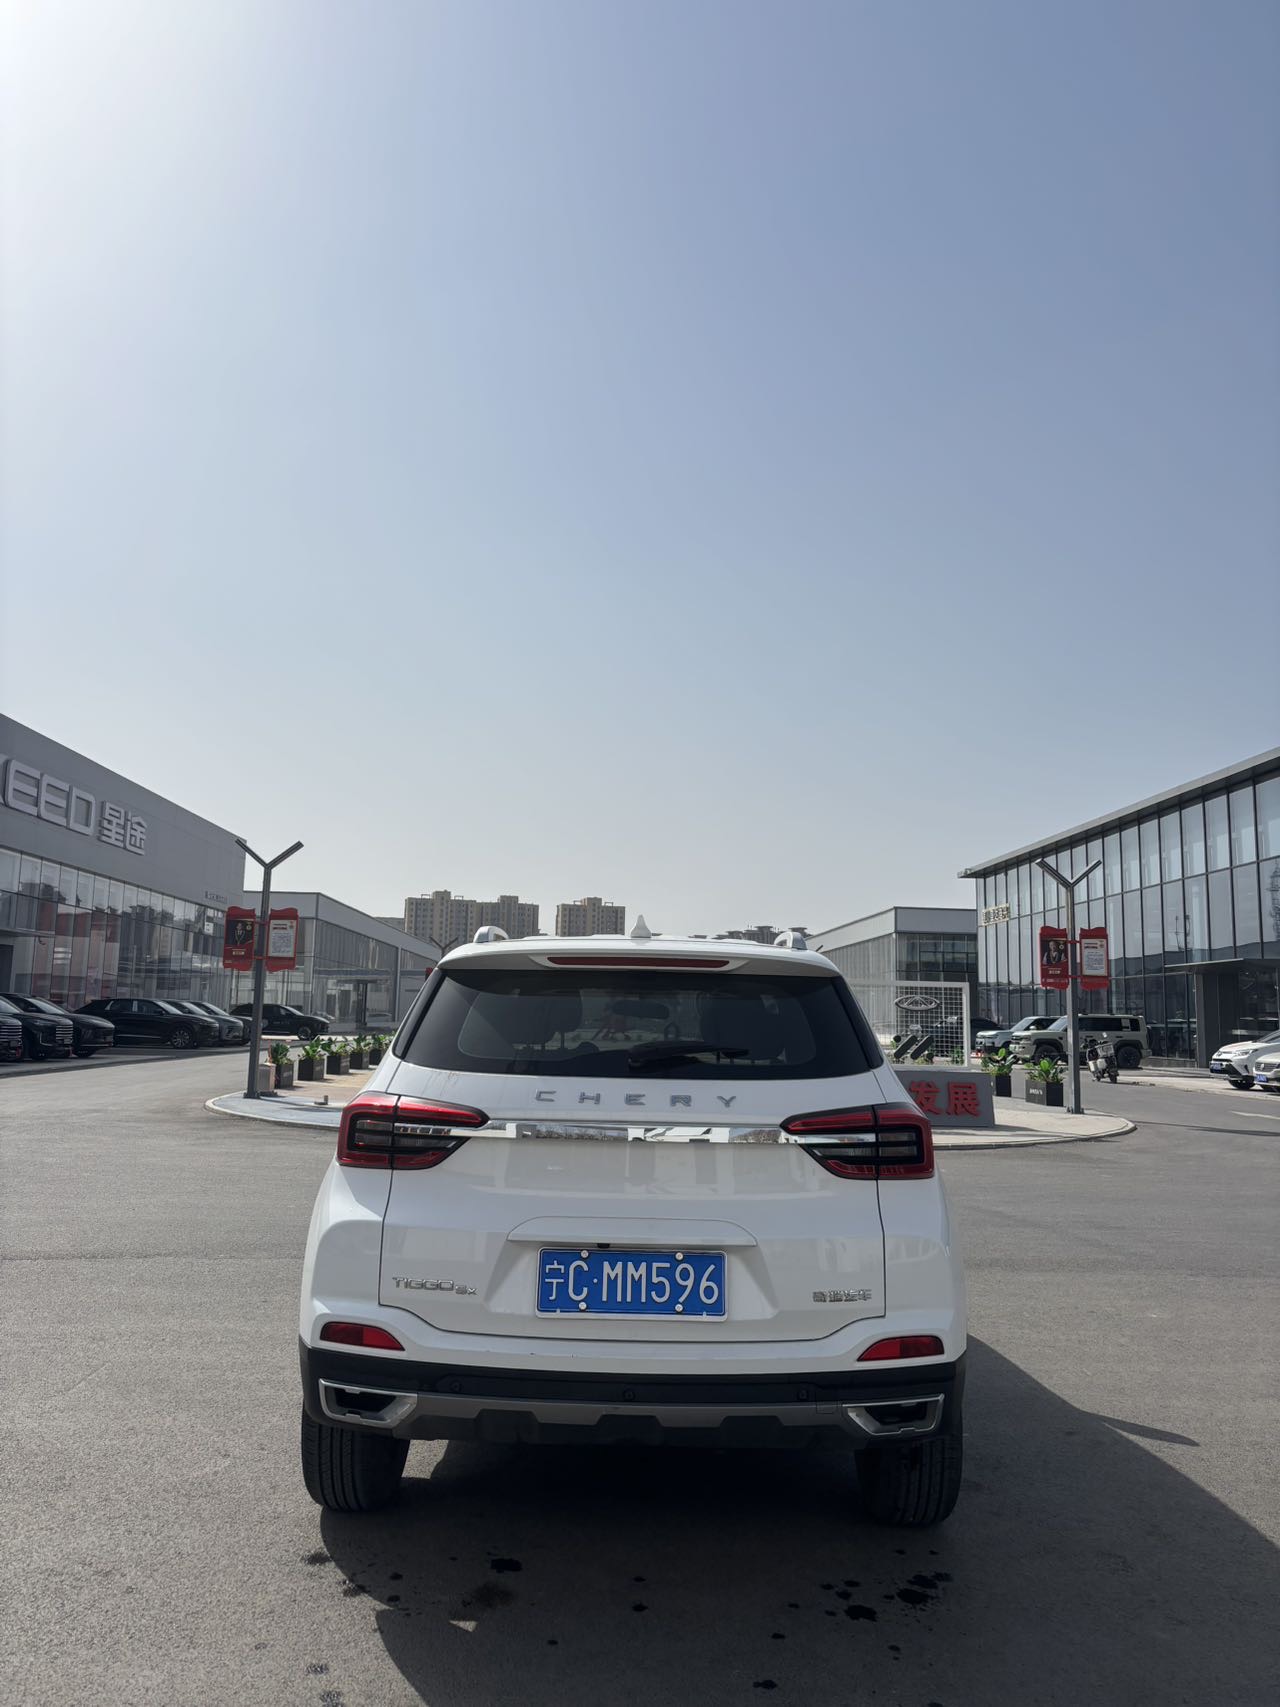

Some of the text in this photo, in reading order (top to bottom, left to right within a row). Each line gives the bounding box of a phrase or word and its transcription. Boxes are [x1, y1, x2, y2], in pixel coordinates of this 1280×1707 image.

[0, 753, 147, 855] EED 星途
[535, 1090, 736, 1108] CHERY
[909, 1081, 981, 1117] 发展
[392, 1277, 454, 1291] TIGGO
